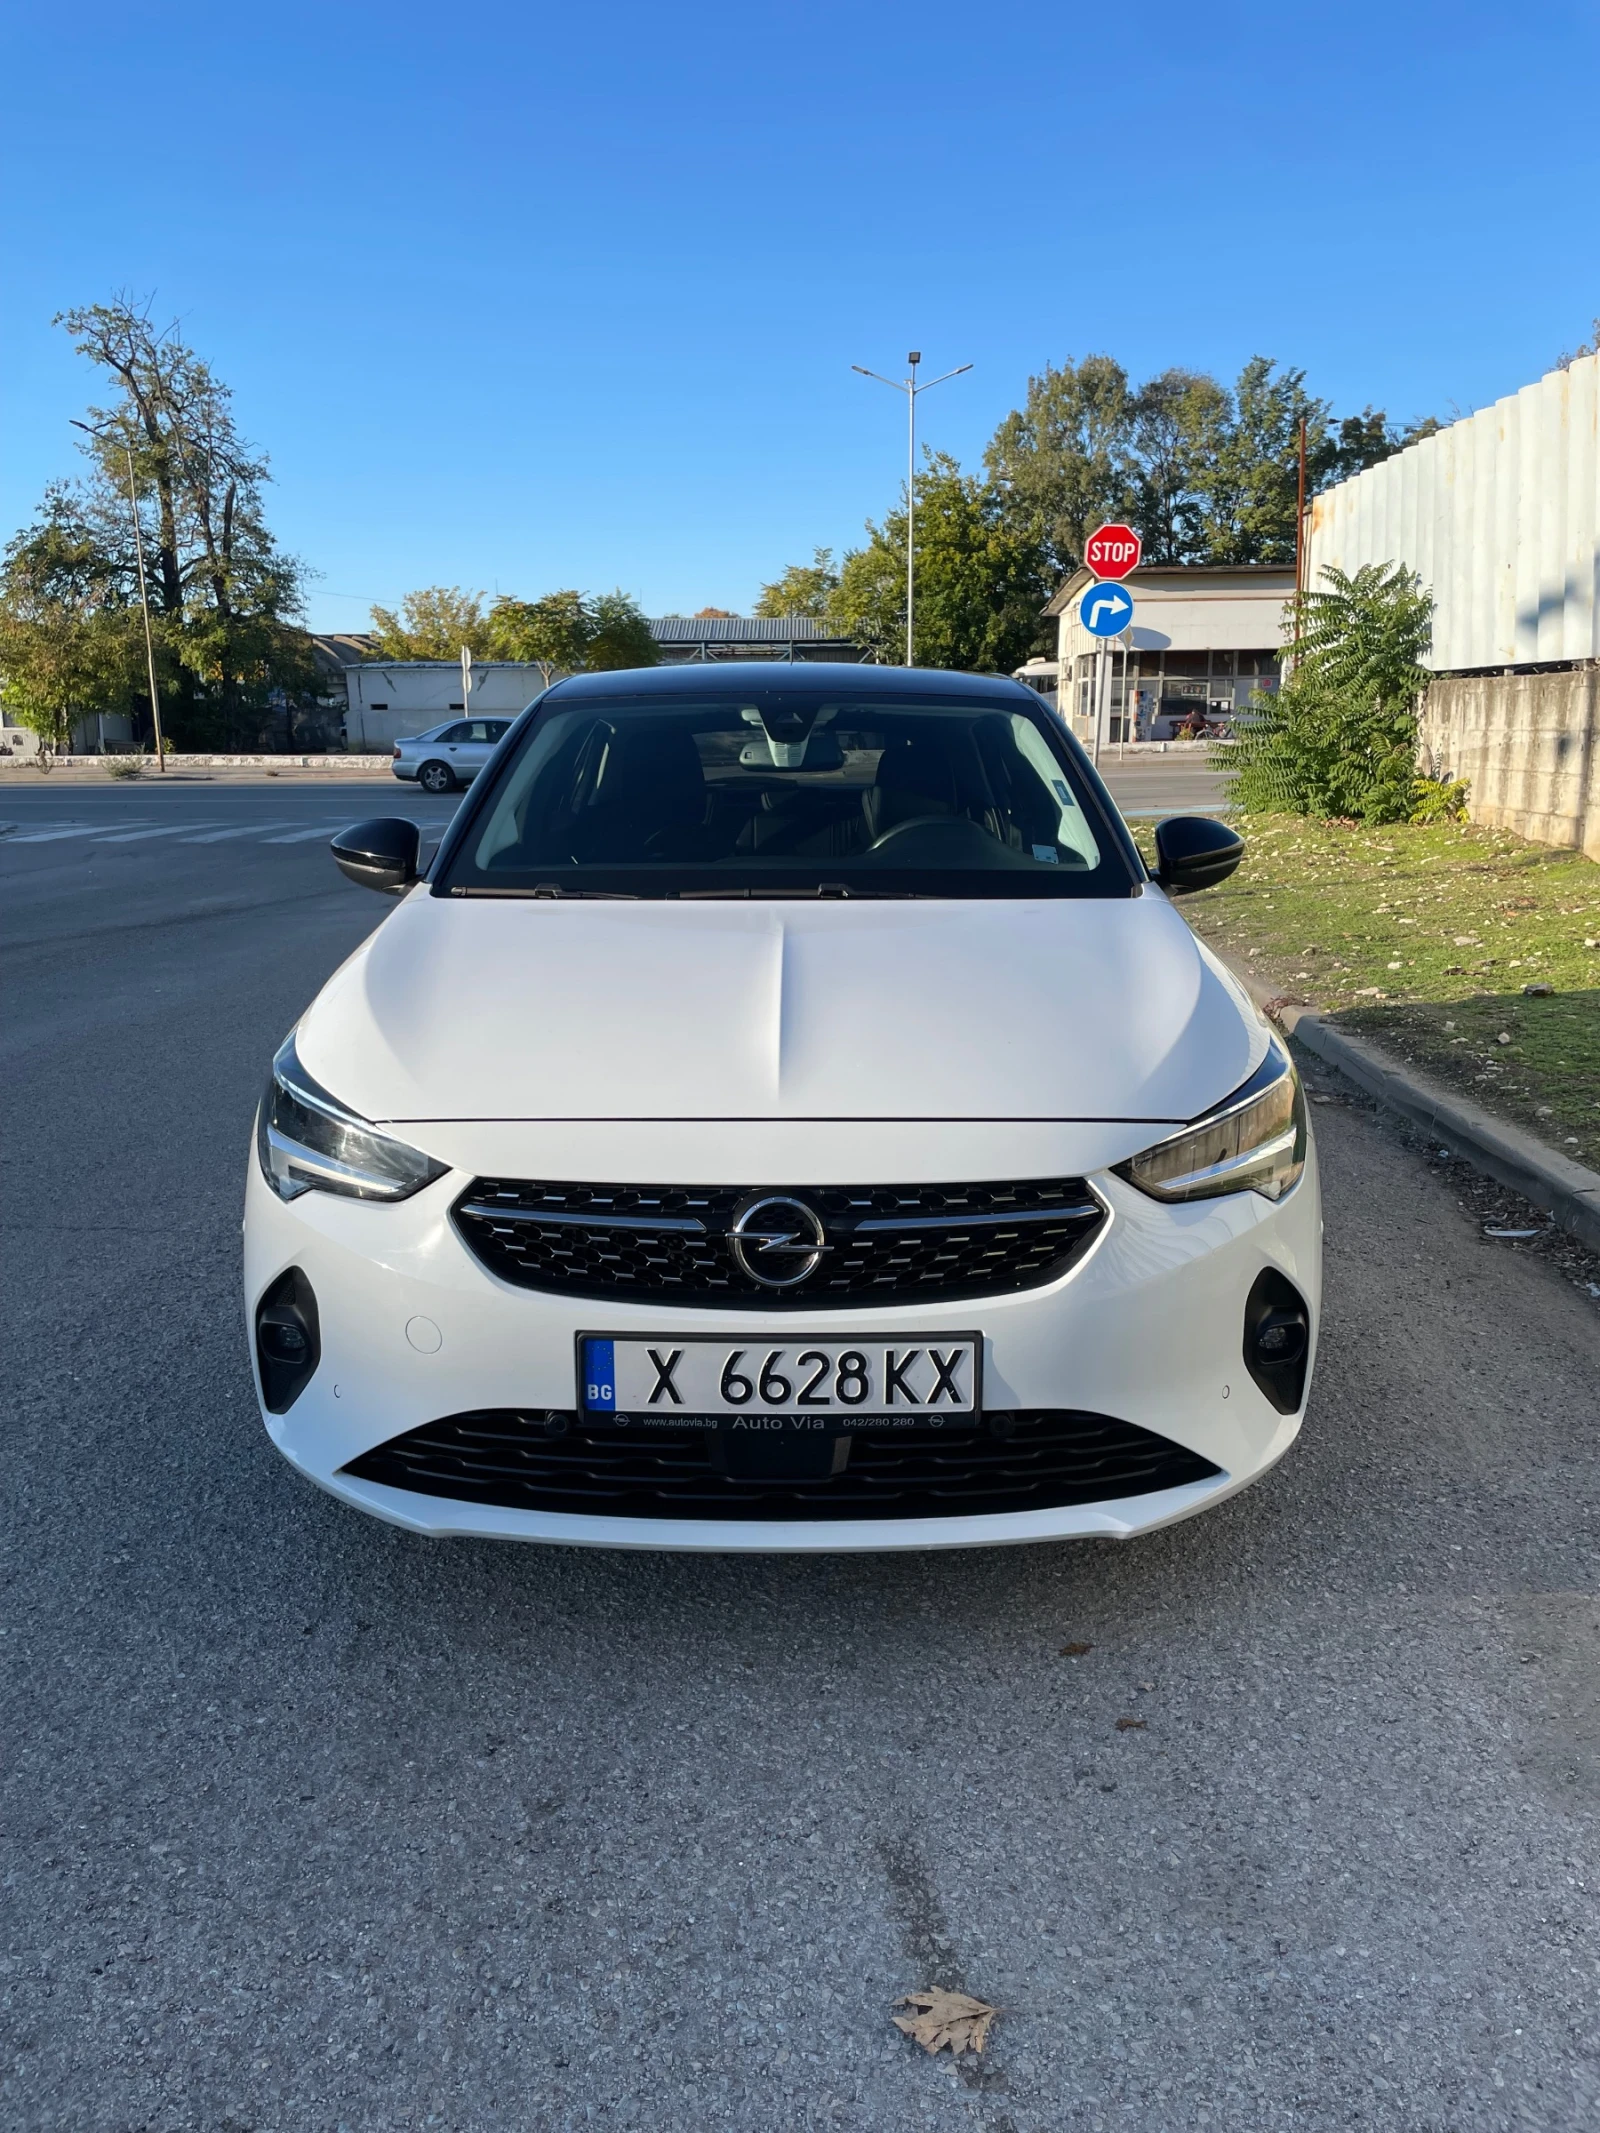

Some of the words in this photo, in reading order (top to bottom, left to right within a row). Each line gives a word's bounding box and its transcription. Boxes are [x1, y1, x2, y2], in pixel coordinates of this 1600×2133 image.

[1091, 541, 1135, 562] STOP
[646, 1349, 684, 1404] X
[587, 1384, 612, 1400] BG
[643, 1417, 718, 1429] www.autovia.bg
[732, 1416, 783, 1430] Auto
[790, 1416, 825, 1430] Via
[843, 1417, 890, 1427] 042/280
[892, 1417, 915, 1427] 280
